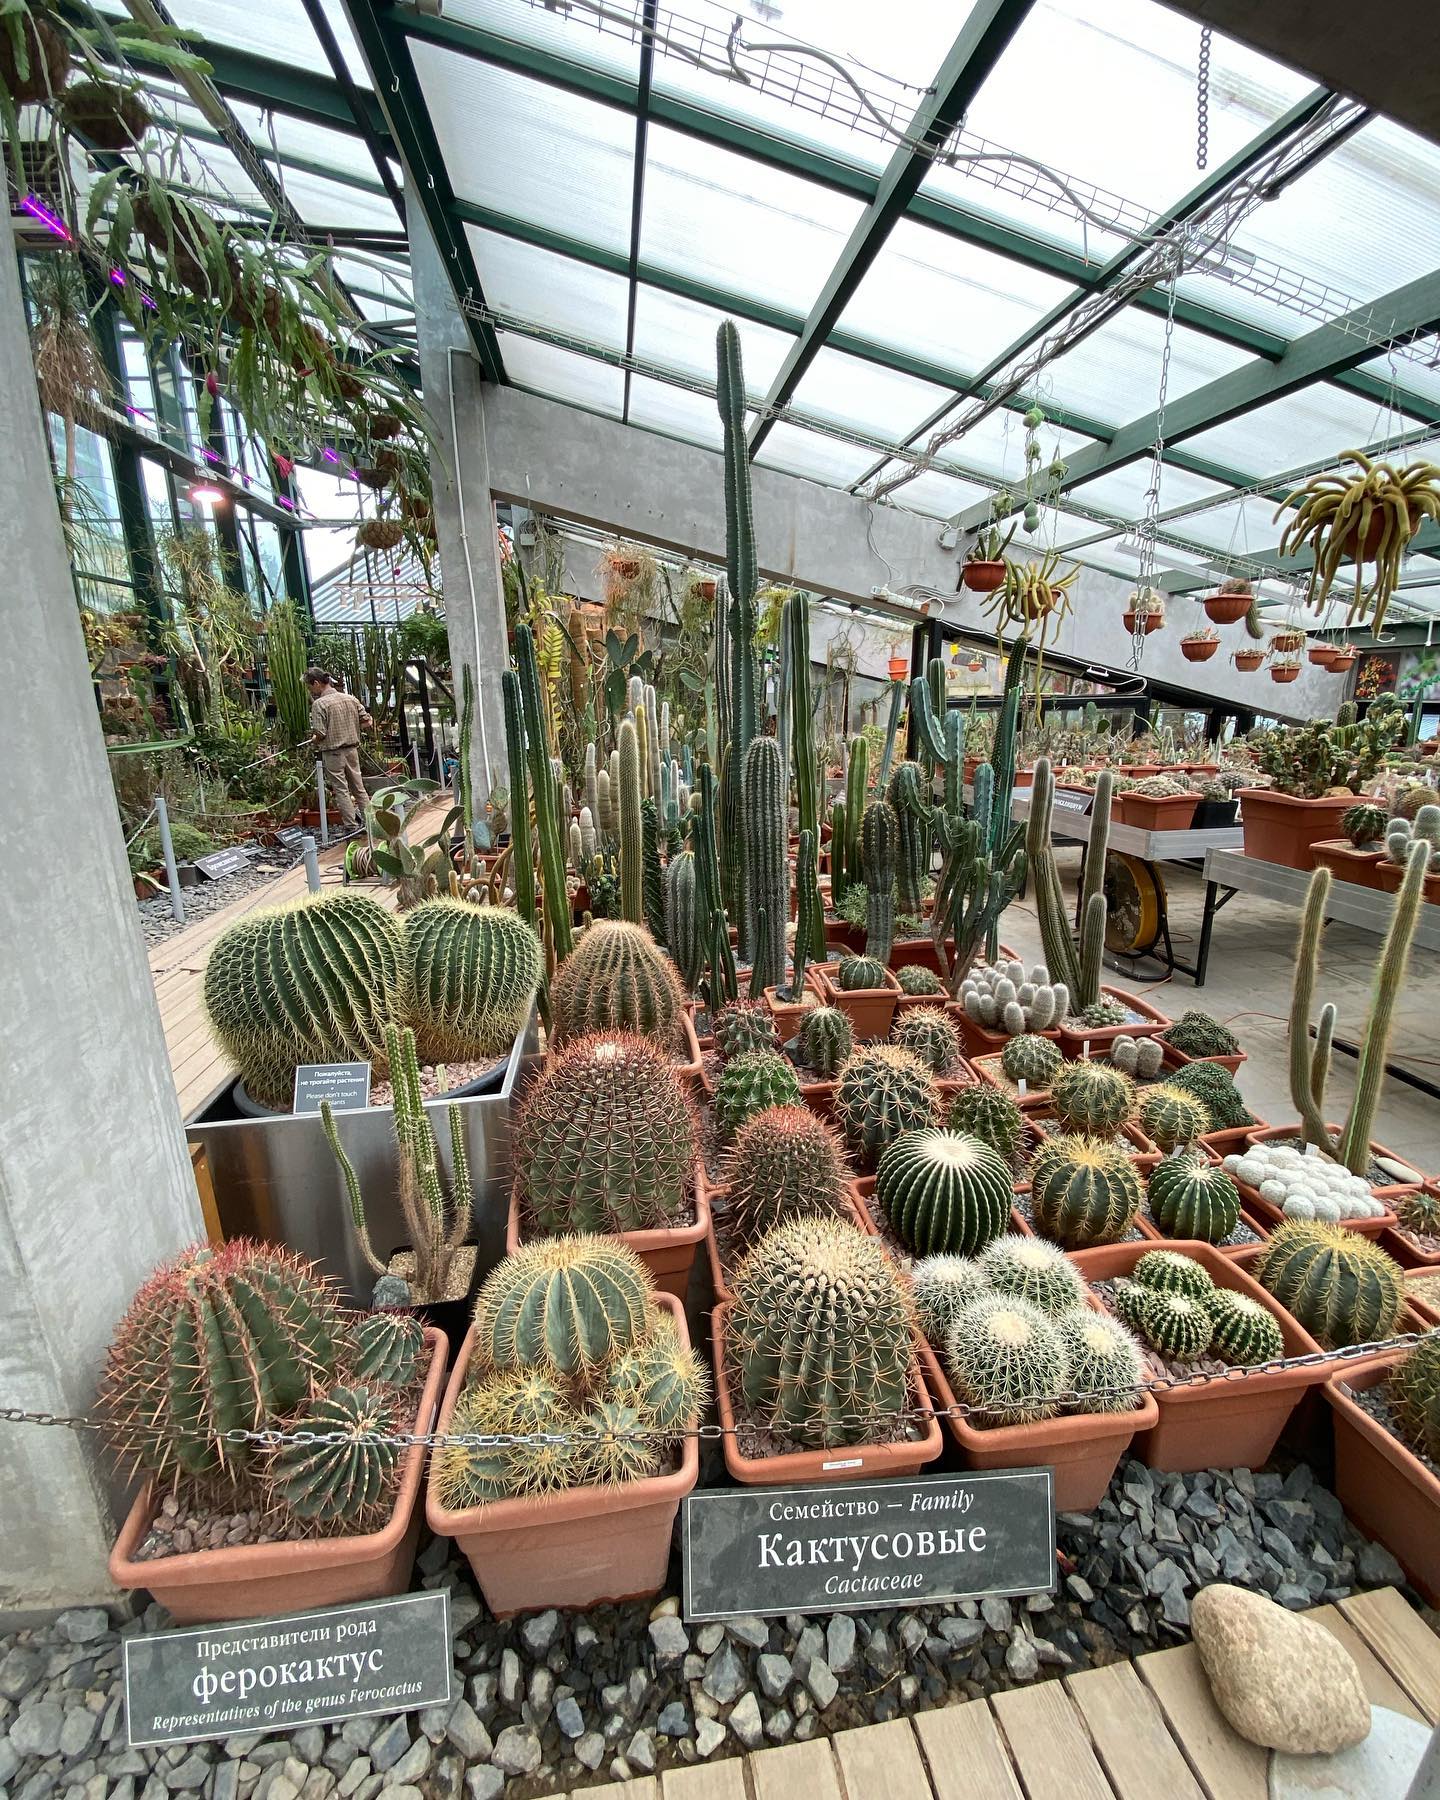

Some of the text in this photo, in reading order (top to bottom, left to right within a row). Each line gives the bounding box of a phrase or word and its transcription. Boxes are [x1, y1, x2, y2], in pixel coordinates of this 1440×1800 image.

[336, 1077, 365, 1085] растения
[340, 1090, 358, 1098] touch
[768, 1498, 880, 1522] Семейство
[909, 1490, 975, 1513] Family
[757, 1525, 988, 1572] Кактусовые
[824, 1572, 924, 1595] Cactaceae
[196, 1619, 377, 1660] Представители рода
[192, 1648, 384, 1704] ферокактус
[152, 1681, 423, 1732] Representatives of the genus Ferocactus
